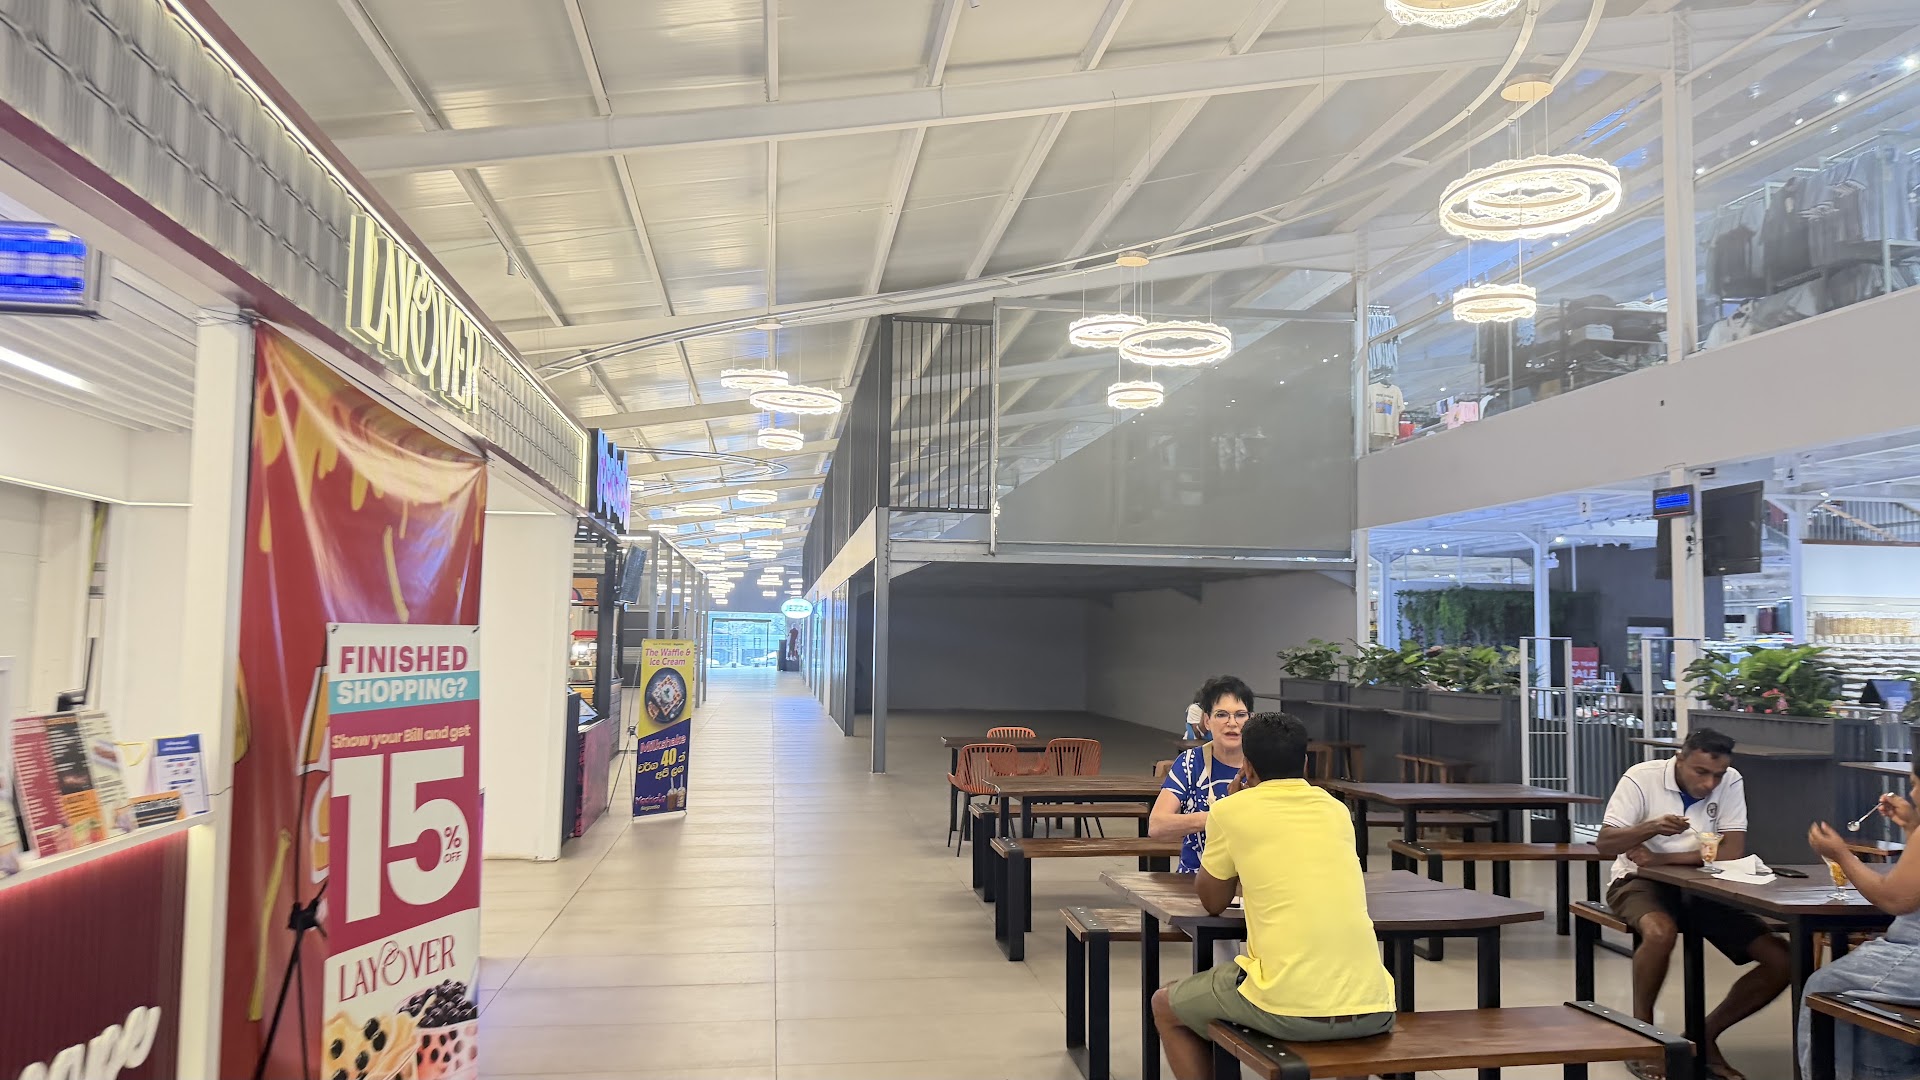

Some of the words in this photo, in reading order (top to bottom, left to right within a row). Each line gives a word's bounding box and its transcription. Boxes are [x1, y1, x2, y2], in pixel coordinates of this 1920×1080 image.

[346, 213, 481, 416] LAYOVER
[339, 645, 468, 674] FINISHED
[645, 648, 659, 657] The
[660, 648, 685, 657] Waffle
[685, 648, 691, 657] &
[649, 657, 660, 666] Ice
[661, 657, 686, 666] Cream
[337, 677, 468, 705] SHOPPING?
[331, 733, 370, 750] Show
[371, 731, 403, 750] your
[403, 726, 424, 743] Bill
[424, 725, 449, 741] and
[449, 724, 472, 742] get
[640, 734, 687, 754] Milkshake
[661, 747, 677, 766] 40
[331, 745, 469, 924] 15
[443, 825, 462, 851] %
[443, 850, 462, 864] OFF
[339, 935, 456, 1003] LAYOVER
